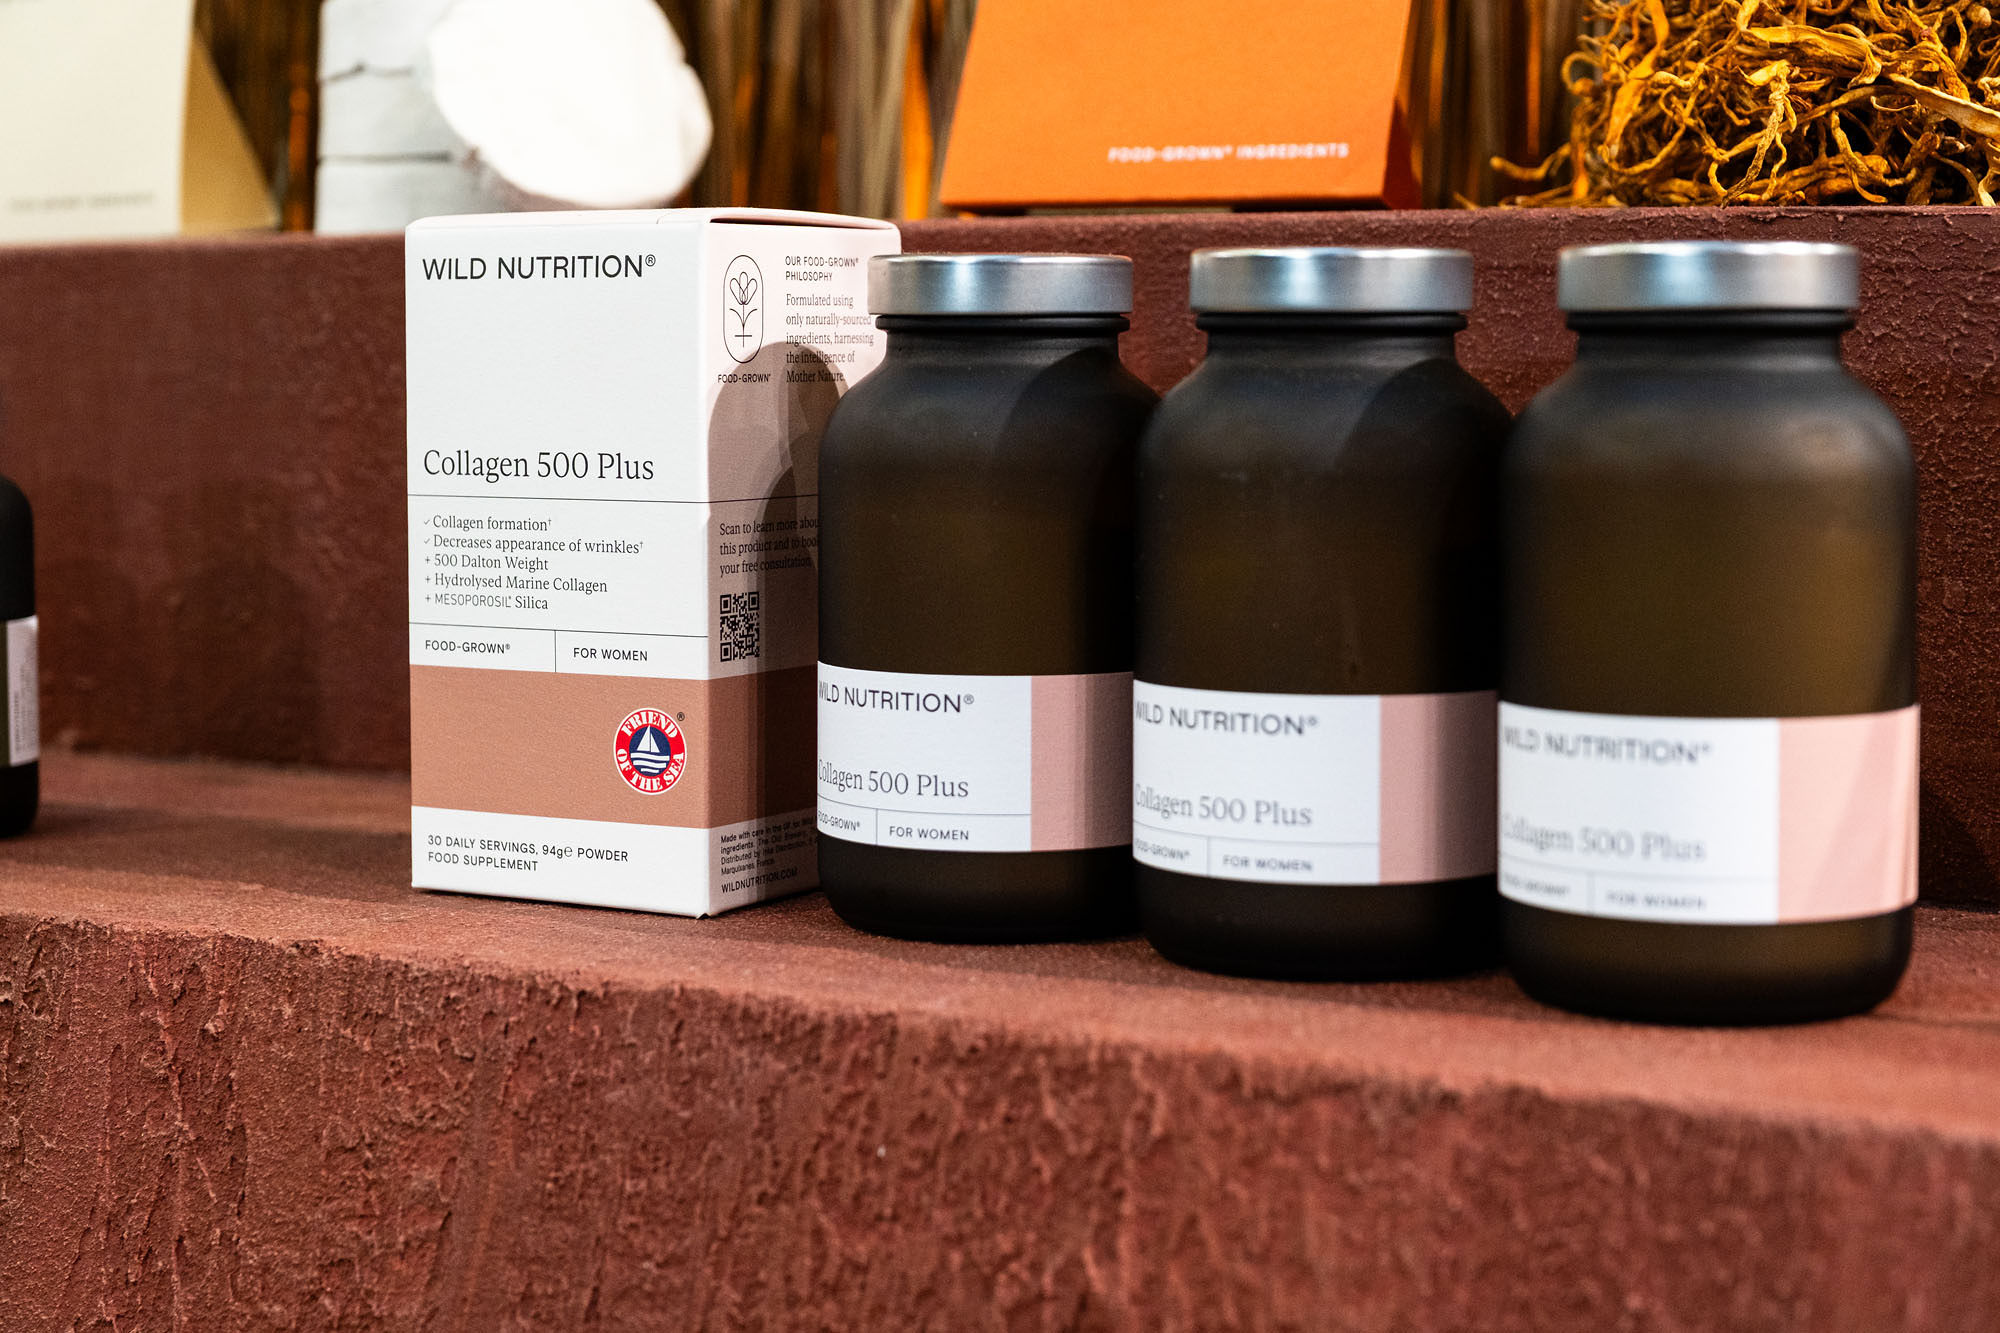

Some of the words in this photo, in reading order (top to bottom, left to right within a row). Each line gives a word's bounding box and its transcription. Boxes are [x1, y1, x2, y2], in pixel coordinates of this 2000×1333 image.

[1236, 142, 1349, 159] INGREDIENTS
[423, 258, 487, 280] WILD
[498, 254, 656, 279] NUTRITION®
[785, 255, 801, 266] OUR
[785, 271, 832, 281] PHILOSOPHY
[786, 293, 830, 306] Formulated
[833, 296, 853, 309] using
[786, 313, 803, 327] only
[806, 314, 872, 326] naturally-sourced
[786, 333, 832, 347] ingredients,
[834, 333, 874, 347] harnessing
[786, 351, 800, 363] the
[801, 350, 846, 365] intelligence
[847, 350, 856, 363] of
[786, 370, 816, 383] Mother
[423, 449, 528, 483] Collagen
[537, 452, 589, 480] 500
[598, 452, 654, 481] Plus
[433, 514, 484, 532] Collagen
[720, 523, 741, 536] Scan
[743, 523, 751, 534] to
[753, 520, 774, 533] learn
[776, 519, 798, 531] more
[433, 534, 492, 549] Decreases
[495, 538, 566, 552] appearance
[568, 538, 582, 552] of
[720, 543, 737, 556] this
[739, 542, 772, 557] product
[774, 538, 790, 550] and
[791, 538, 800, 549] to
[434, 553, 458, 567] 500
[461, 554, 501, 569] Dalton
[505, 556, 549, 573] Weight
[720, 563, 740, 578] your
[742, 559, 760, 573] free
[435, 572, 502, 590] Hydrolysed
[505, 575, 550, 589] Marine
[553, 577, 608, 595] Collagen
[514, 595, 549, 610] Silica
[573, 647, 598, 659] FOR
[601, 648, 648, 662] WOMEN
[621, 711, 678, 738] FRIEND
[617, 748, 632, 772] OF
[630, 771, 663, 791] THE
[663, 752, 685, 786] SEA
[818, 759, 863, 792] Collagen
[868, 770, 909, 794] 500
[916, 774, 969, 798] Plus
[1199, 796, 1247, 822] 500
[1254, 799, 1313, 826] Plus
[721, 834, 737, 843] Made
[739, 831, 751, 840] with
[889, 825, 913, 839] FOR
[918, 828, 970, 841] WOMEN
[428, 834, 442, 846] 30
[446, 836, 476, 849] DAILY
[479, 839, 539, 856] SERVINGS,
[577, 847, 629, 862] POWDER
[428, 851, 459, 865] FOOD
[463, 855, 538, 872] SUPPLEMENT
[1223, 854, 1249, 868] FOR
[1255, 857, 1313, 872] WOMEN
